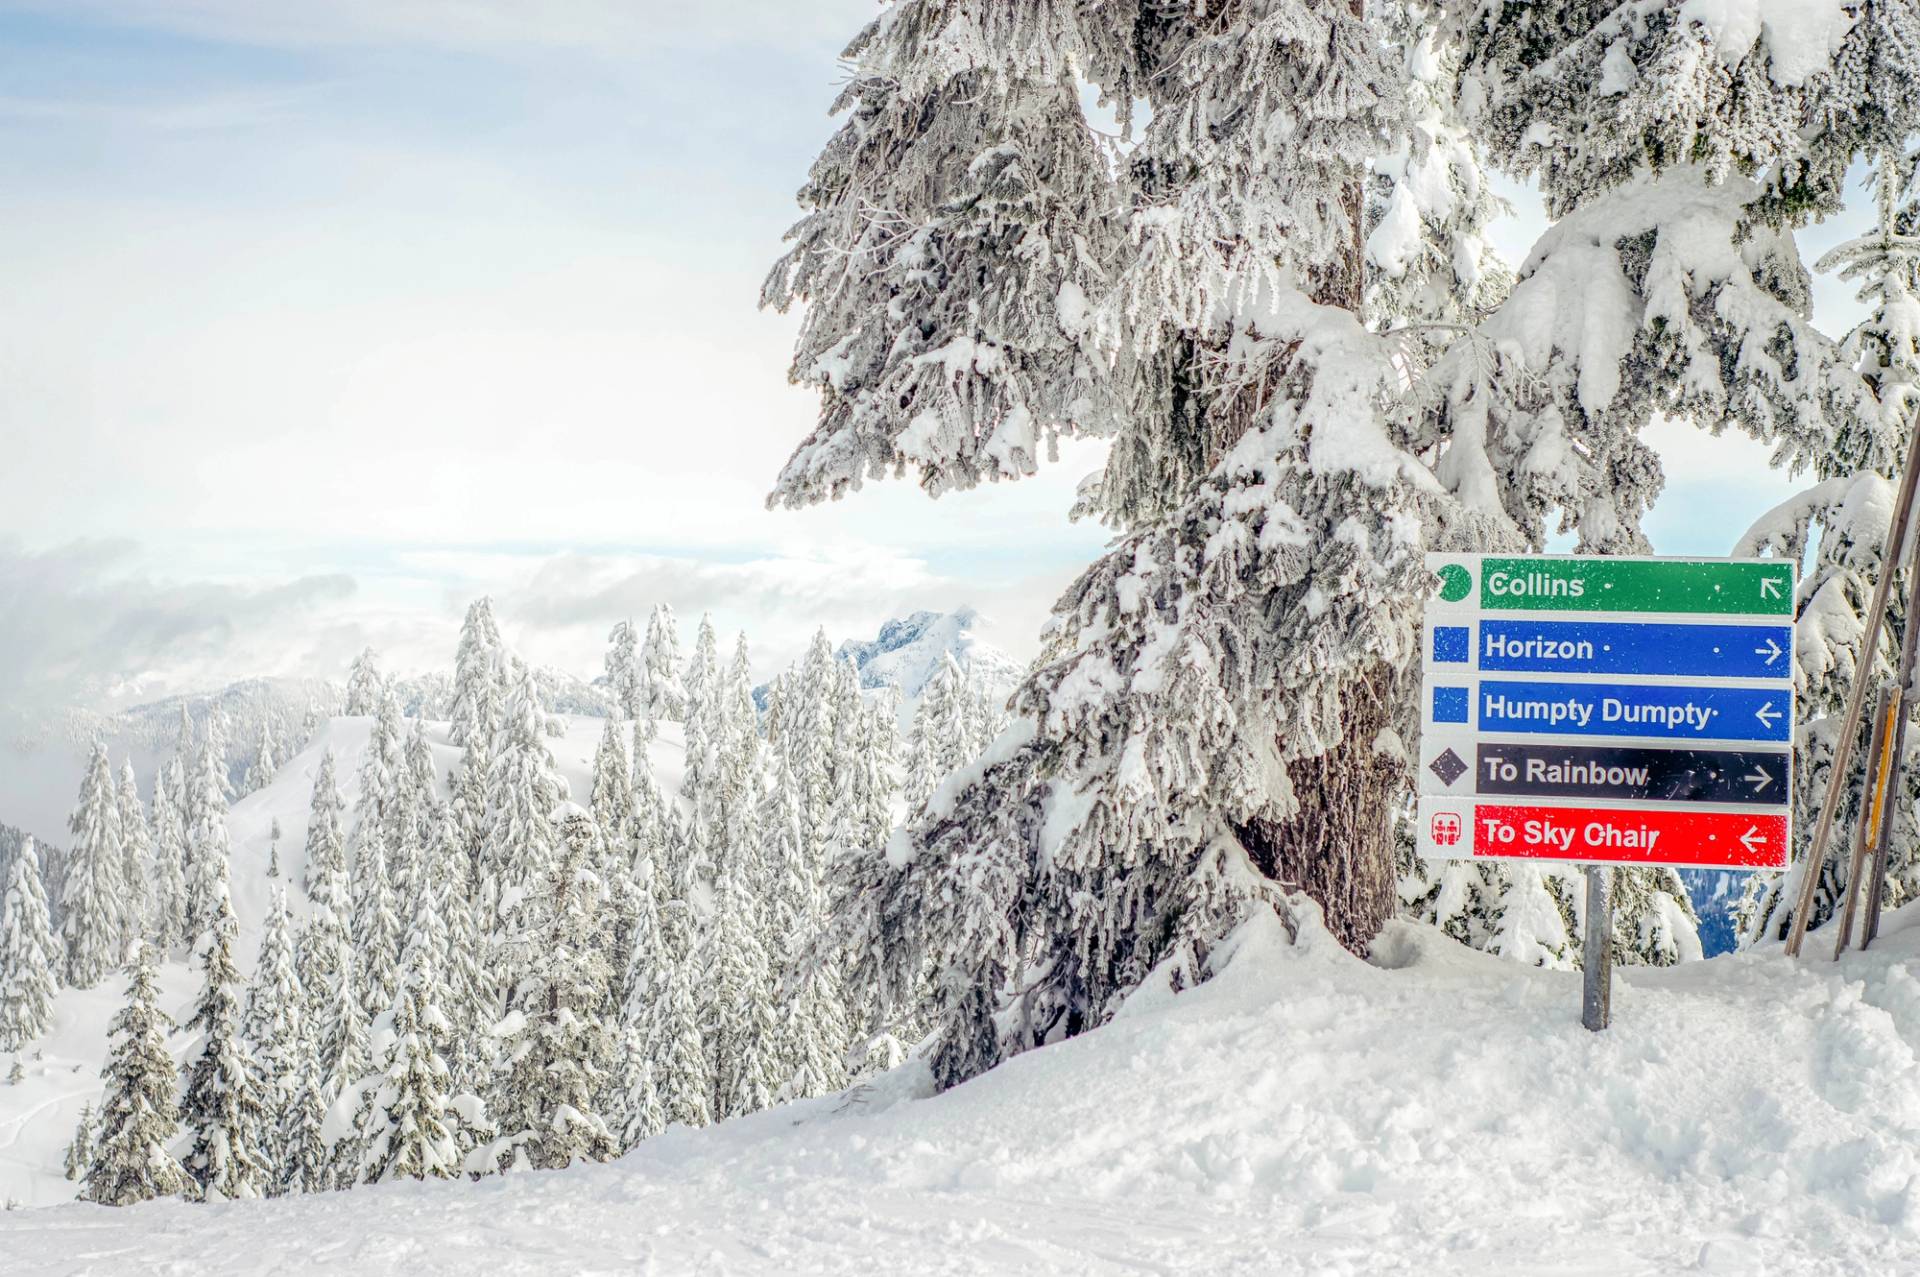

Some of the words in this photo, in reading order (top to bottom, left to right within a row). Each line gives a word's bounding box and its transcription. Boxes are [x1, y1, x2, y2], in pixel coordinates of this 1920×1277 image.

[1489, 572, 1584, 596] Collins
[1486, 634, 1593, 658] Horizon
[1486, 695, 1593, 726] Humpty
[1603, 699, 1711, 730] Dumpty
[1485, 757, 1517, 781] To
[1527, 758, 1648, 785] Rainbow
[1483, 819, 1515, 843] To
[1524, 821, 1576, 851] Sky
[1585, 823, 1658, 848] Chair
